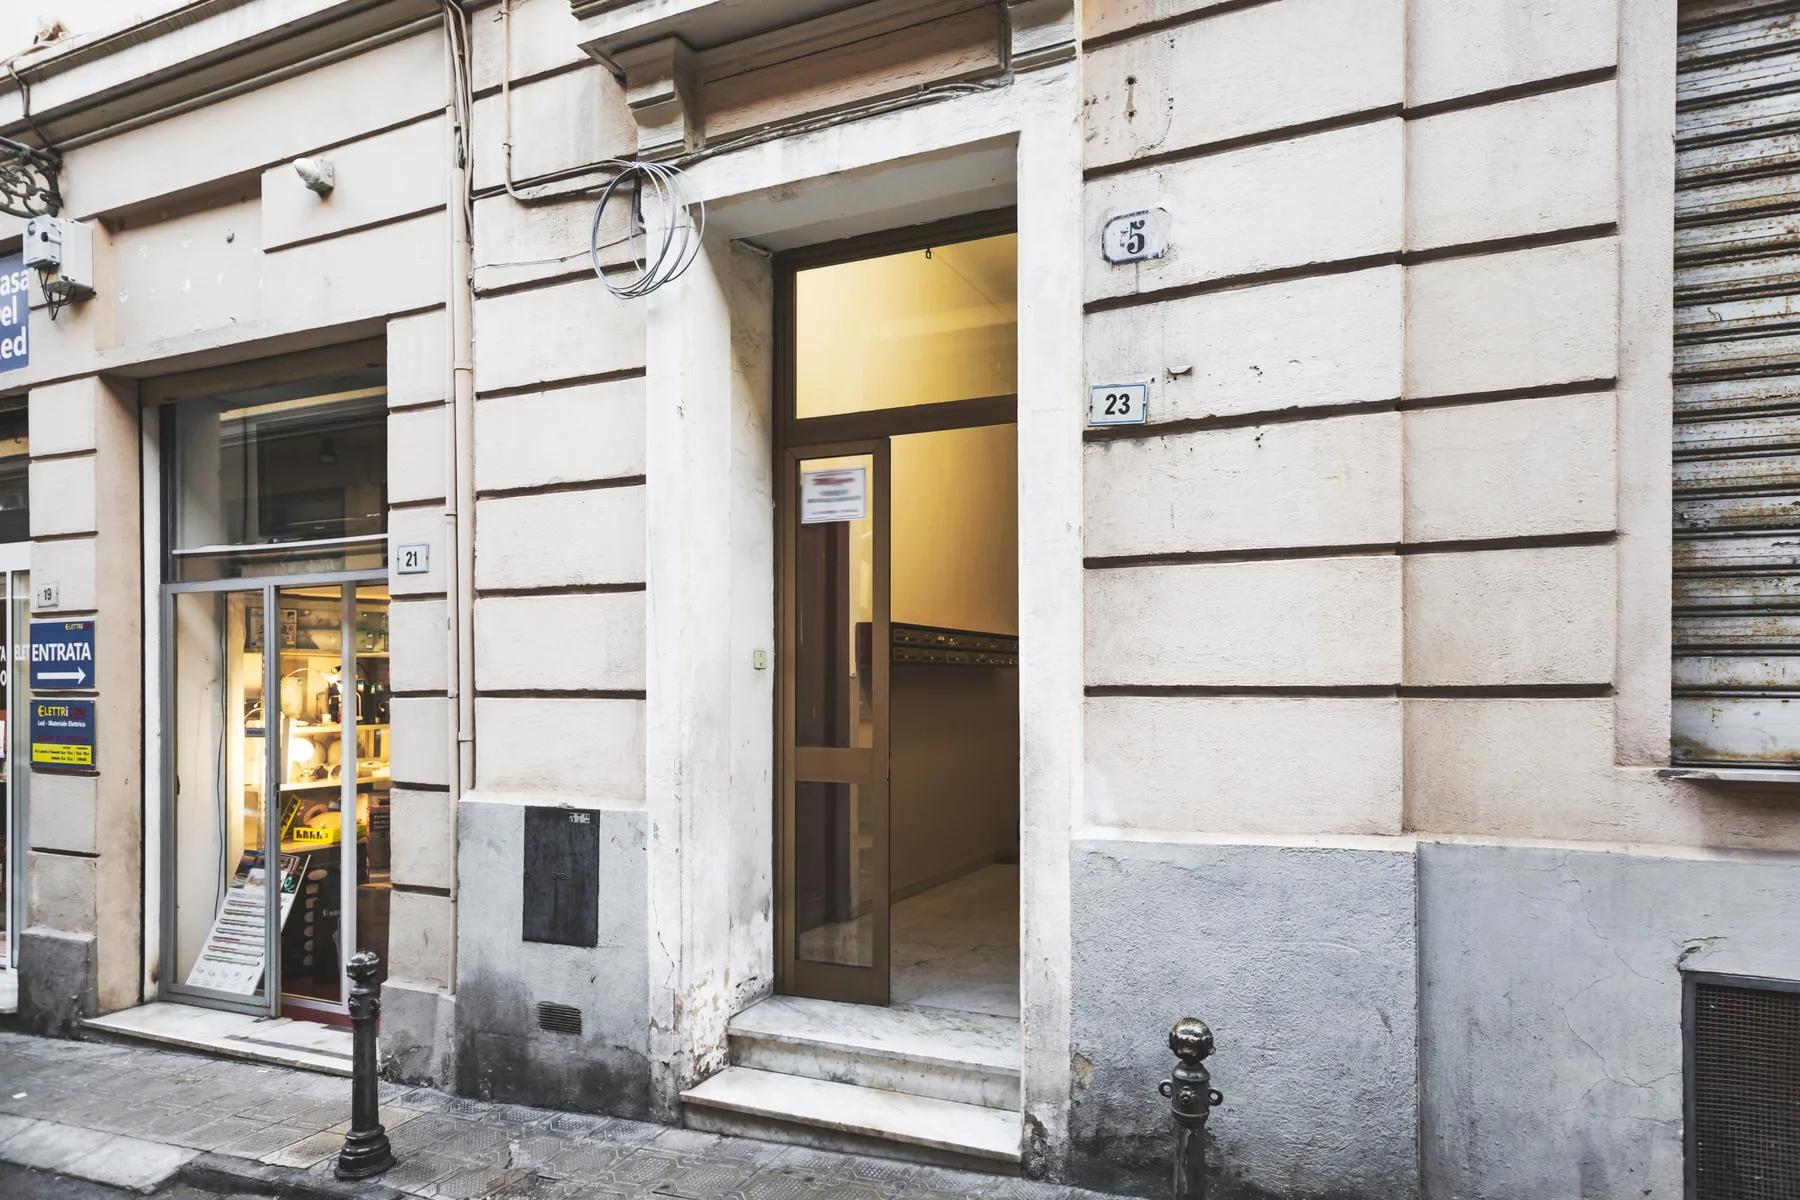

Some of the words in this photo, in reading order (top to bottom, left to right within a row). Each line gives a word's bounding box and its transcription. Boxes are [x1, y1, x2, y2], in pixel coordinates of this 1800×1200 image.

[1127, 219, 1146, 254] 5
[0, 269, 29, 296] asa
[0, 295, 17, 327] el
[0, 325, 27, 359] ed
[1104, 393, 1131, 415] 23
[405, 551, 418, 567] 21
[44, 587, 52, 601] 19
[31, 642, 92, 662] ENTRATA
